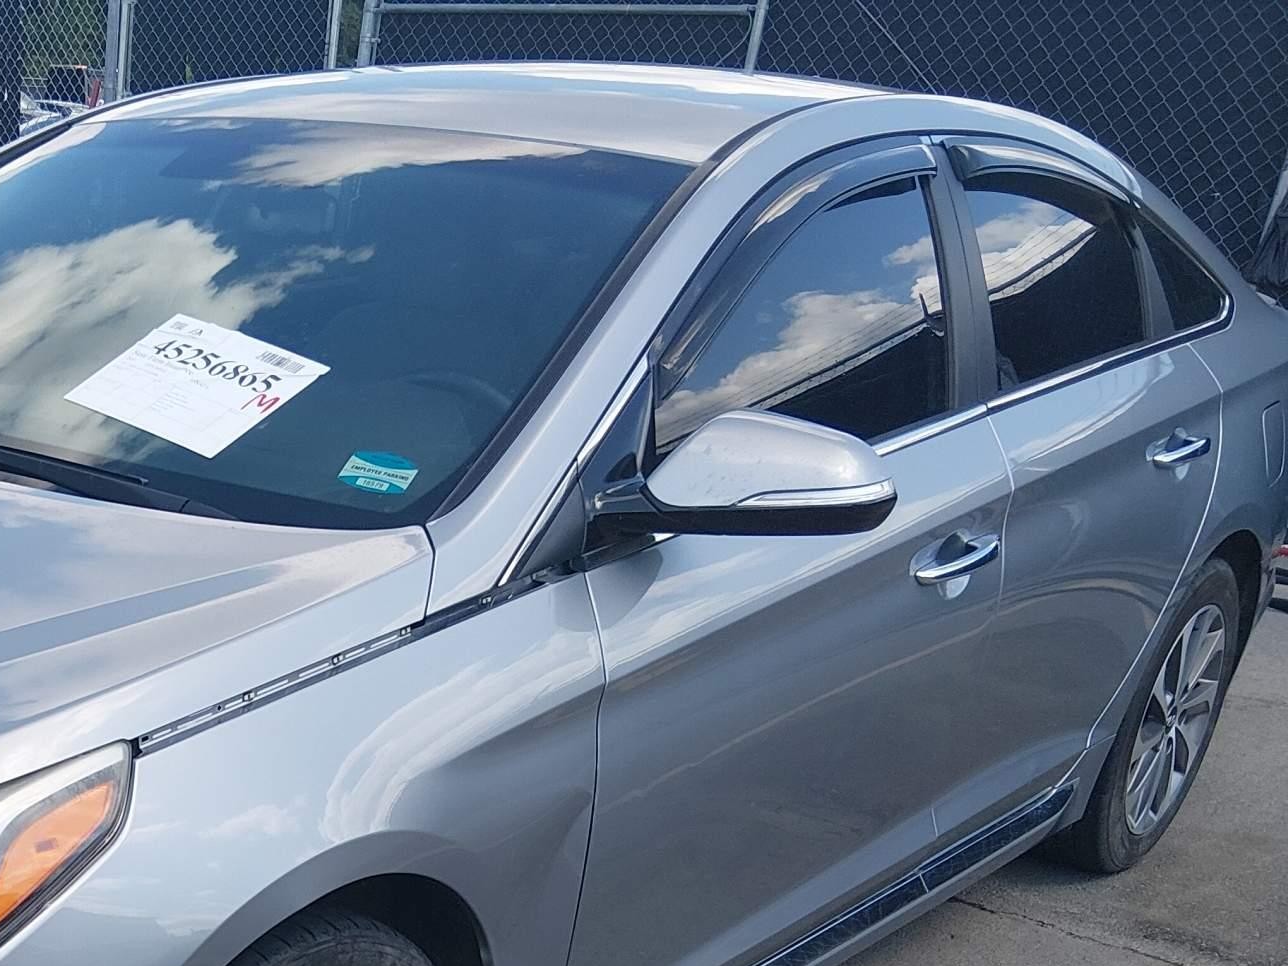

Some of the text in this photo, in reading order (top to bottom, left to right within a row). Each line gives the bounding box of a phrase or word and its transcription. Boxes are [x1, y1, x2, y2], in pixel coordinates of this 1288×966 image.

[153, 339, 283, 394] 45256865
[240, 393, 281, 415] M
[351, 464, 409, 481] EMPLOYEE PARKING
